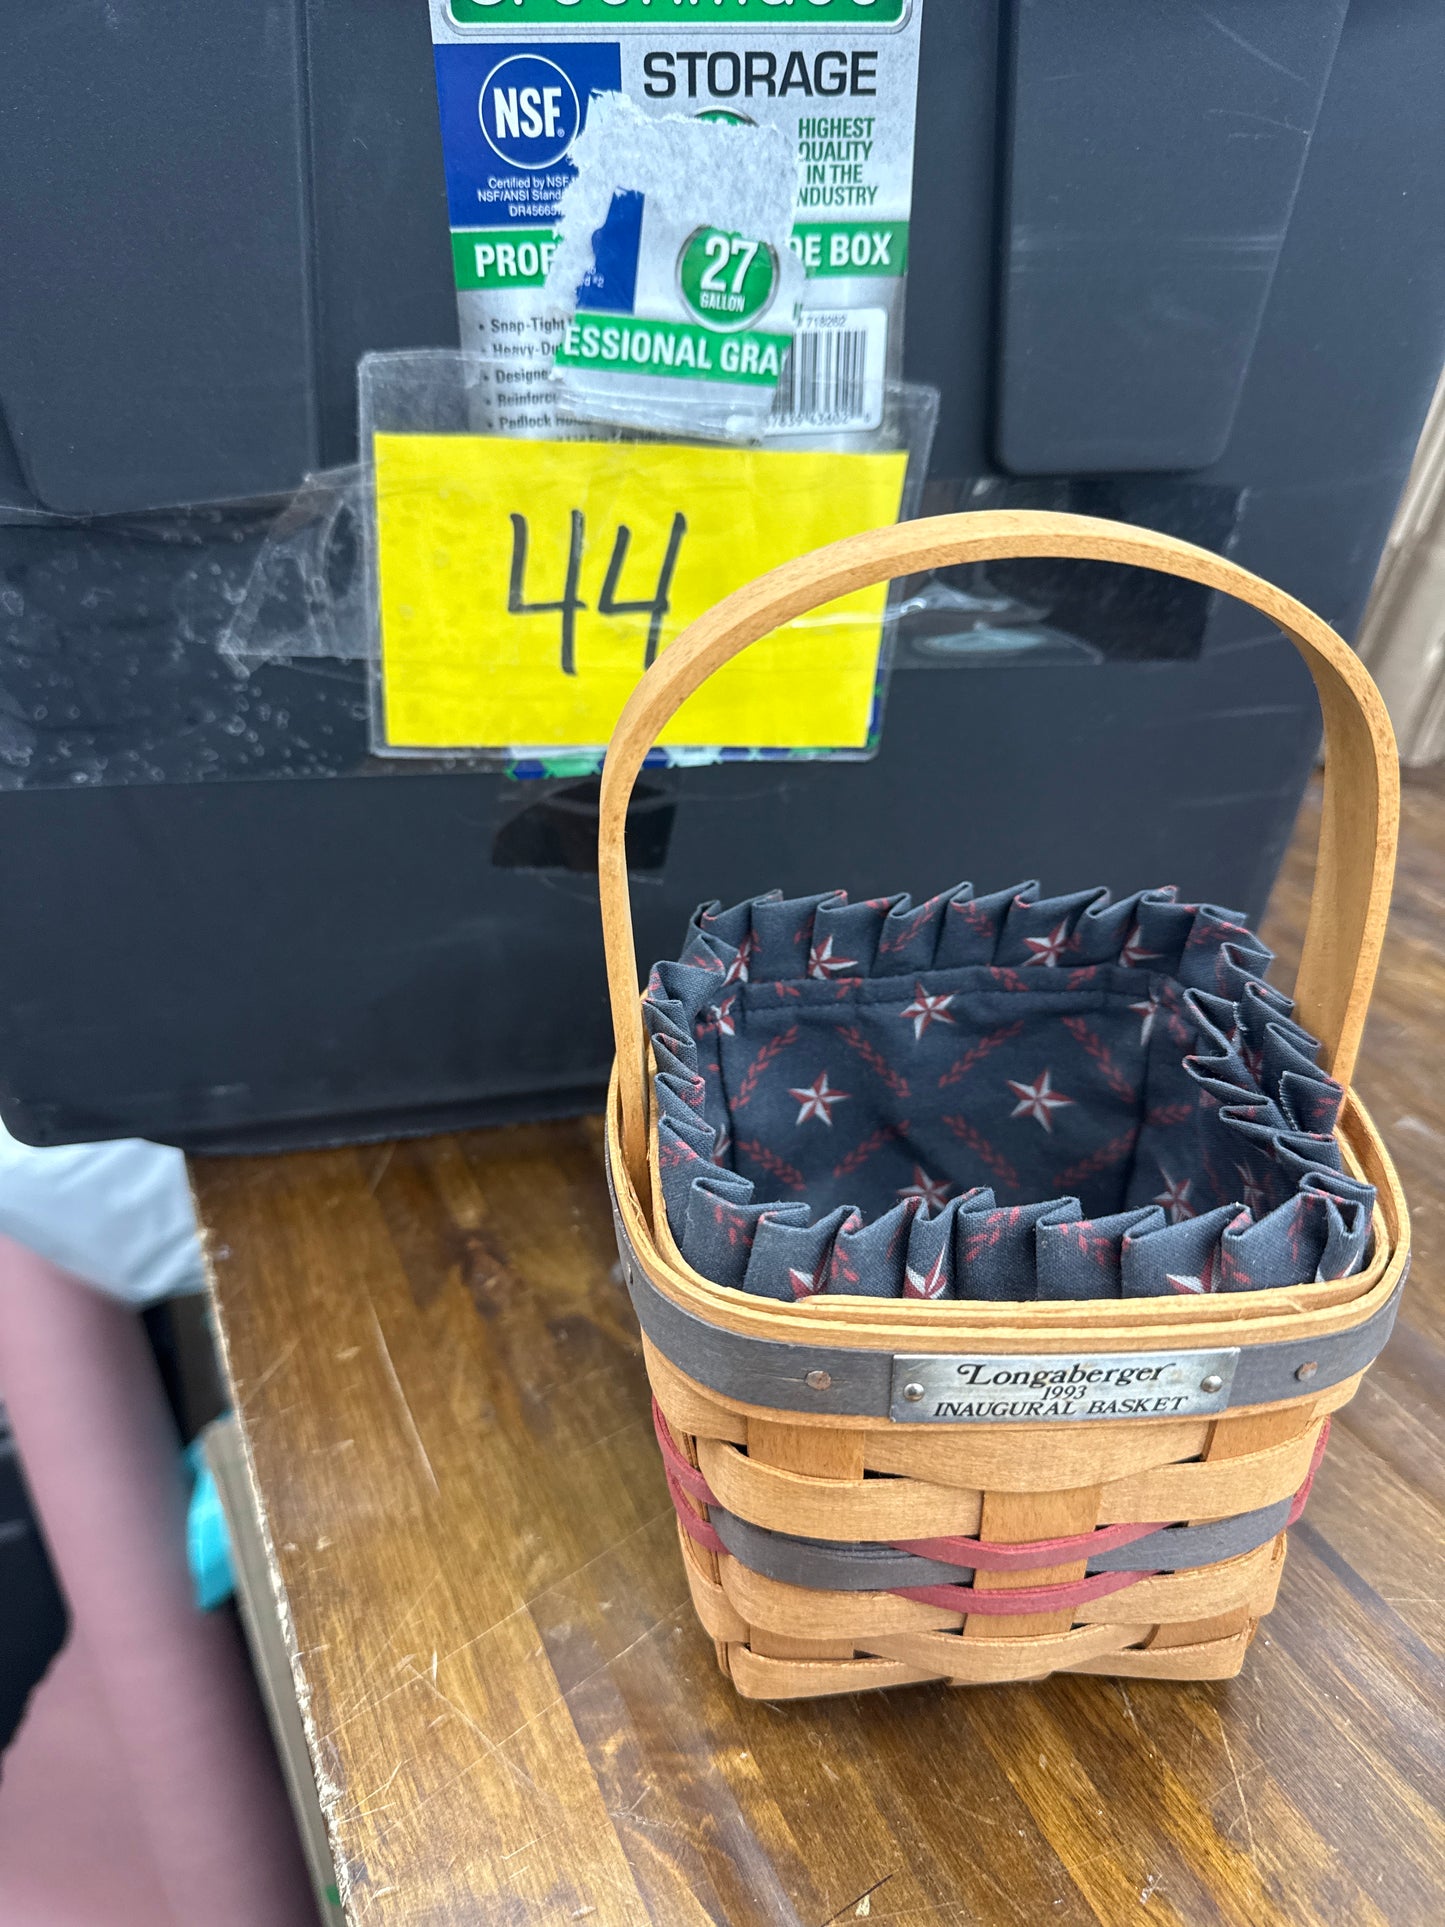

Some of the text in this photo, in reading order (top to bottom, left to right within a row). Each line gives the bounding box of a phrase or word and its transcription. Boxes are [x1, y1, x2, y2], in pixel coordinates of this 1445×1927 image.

[643, 51, 878, 97] STORAGE
[493, 86, 562, 138] NSF
[798, 117, 875, 139] HIGHEST
[798, 140, 873, 161] QUALITY
[488, 176, 530, 189] Certified
[532, 176, 545, 190] by
[807, 164, 863, 184] IN THE
[477, 189, 529, 202] NSF/ANSI
[797, 186, 878, 207] NDUSTRY
[829, 231, 893, 266] BOX
[700, 235, 760, 294] 27
[700, 291, 746, 313] GALLON
[490, 317, 565, 336] Snap-Tight
[563, 324, 714, 370] ESSIONAL
[496, 368, 551, 385] Designe
[499, 413, 551, 431] Padlock
[508, 508, 687, 677] 44
[957, 1362, 1176, 1388] Longaberger
[1041, 1385, 1087, 1400] 1993
[933, 1396, 1188, 1417] INAUGURAL BASKET
